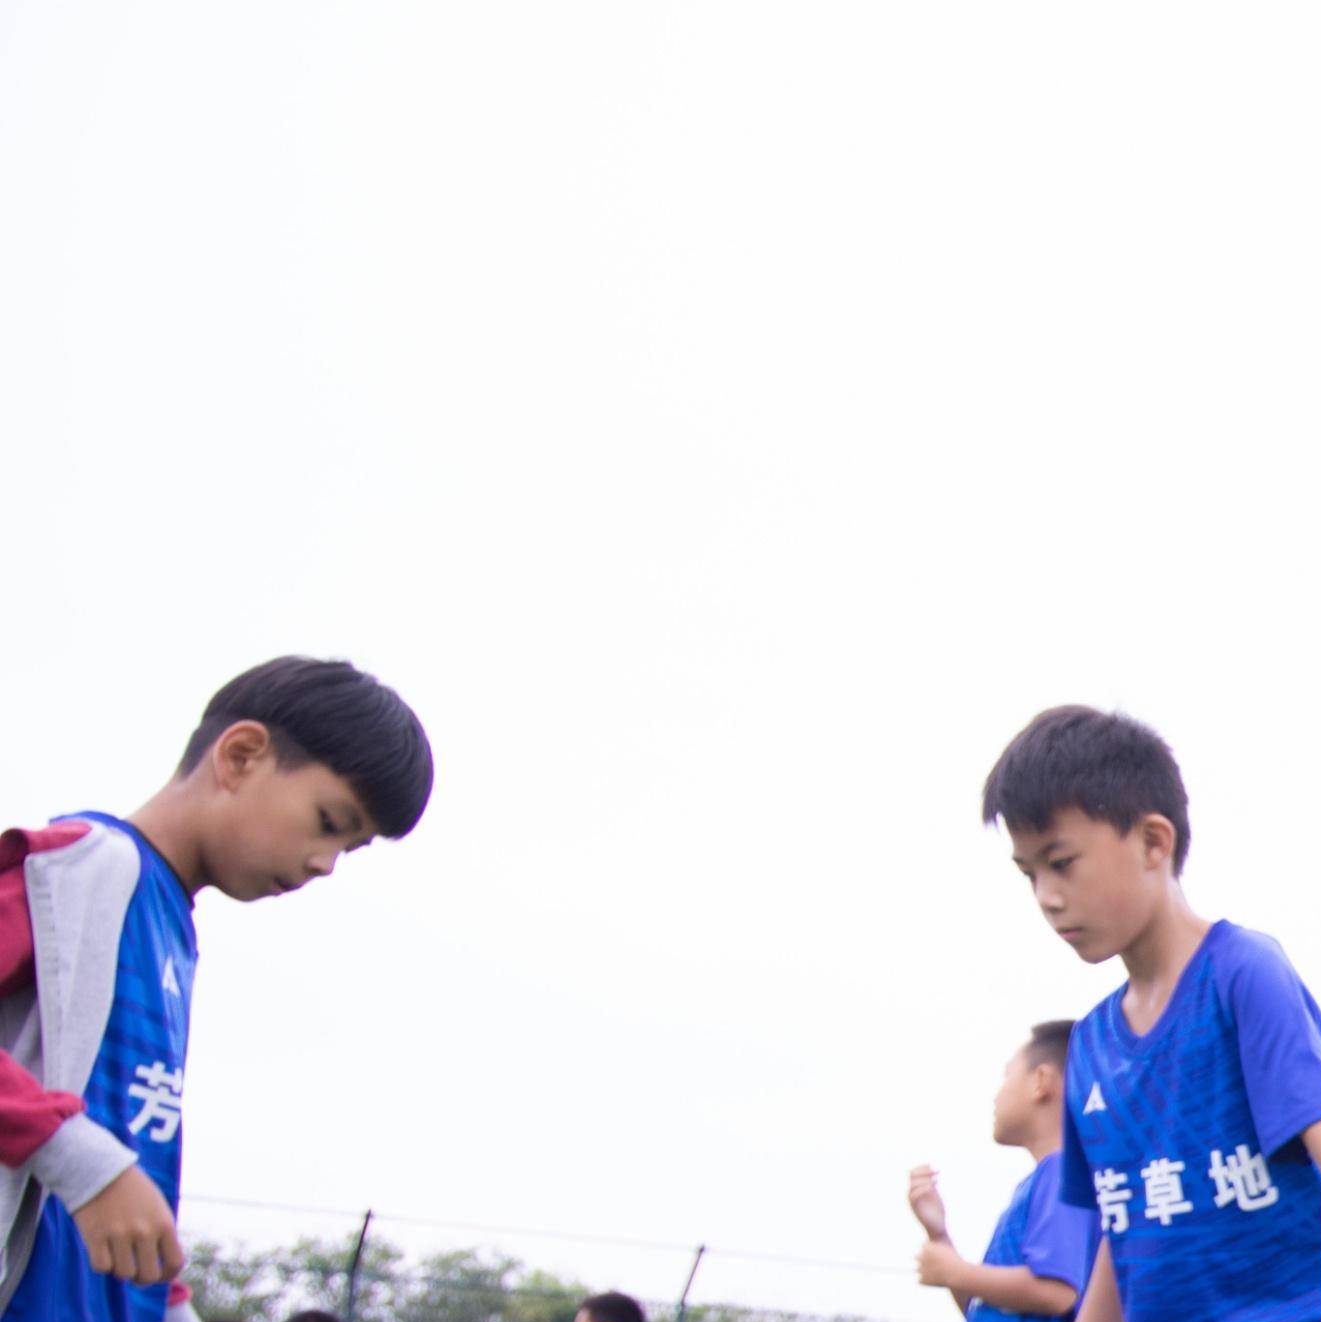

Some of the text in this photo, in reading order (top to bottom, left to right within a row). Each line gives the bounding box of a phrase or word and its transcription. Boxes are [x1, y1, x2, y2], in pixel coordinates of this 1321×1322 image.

[127, 1060, 183, 1142] 芳
[1094, 1144, 1280, 1234] 芳草地
